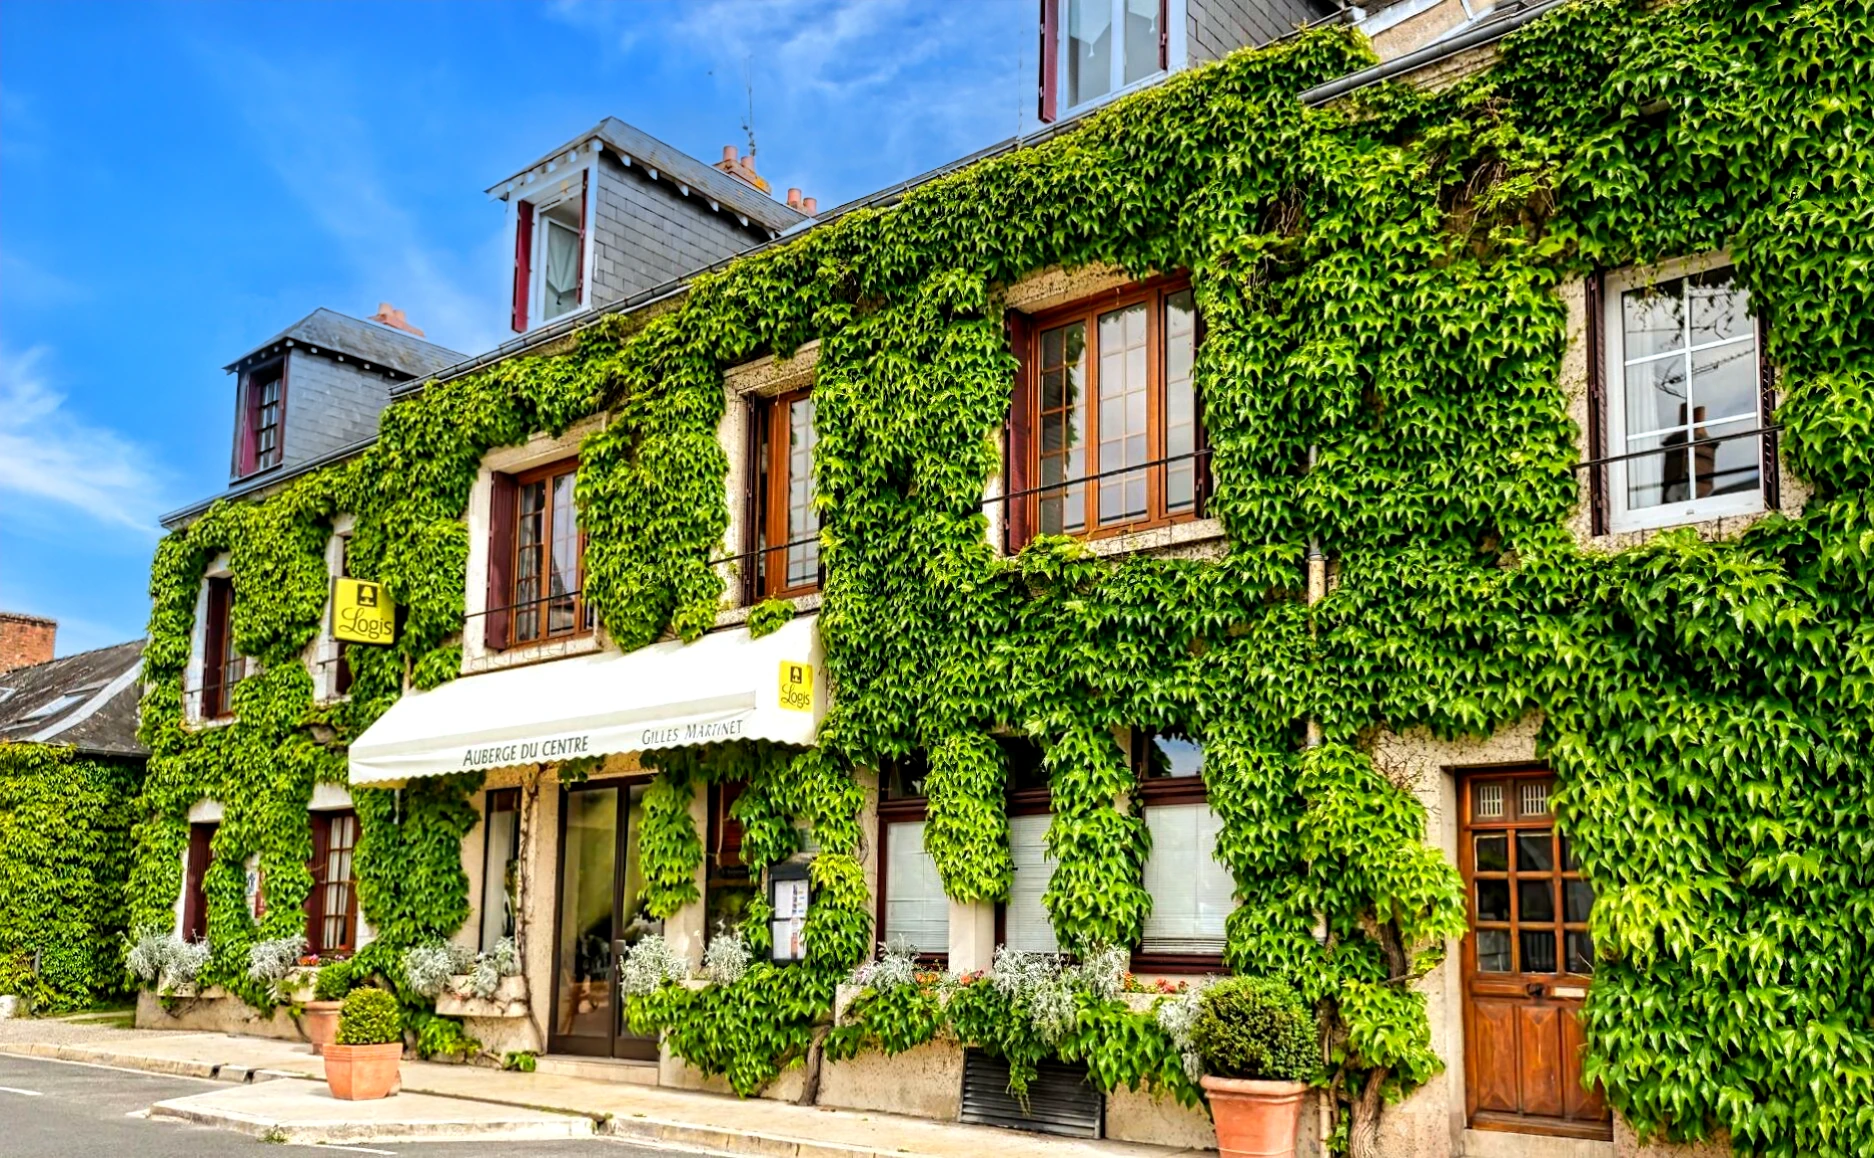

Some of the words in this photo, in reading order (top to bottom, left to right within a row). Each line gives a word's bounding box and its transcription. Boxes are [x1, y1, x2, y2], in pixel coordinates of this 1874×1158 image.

[338, 607, 392, 640] Logis
[780, 683, 810, 709] Logis
[642, 728, 679, 745] GILLES
[684, 719, 743, 740] MARTINET
[463, 745, 518, 767] AUBERGE
[520, 742, 539, 759] DU
[542, 735, 589, 757] CENTRE
